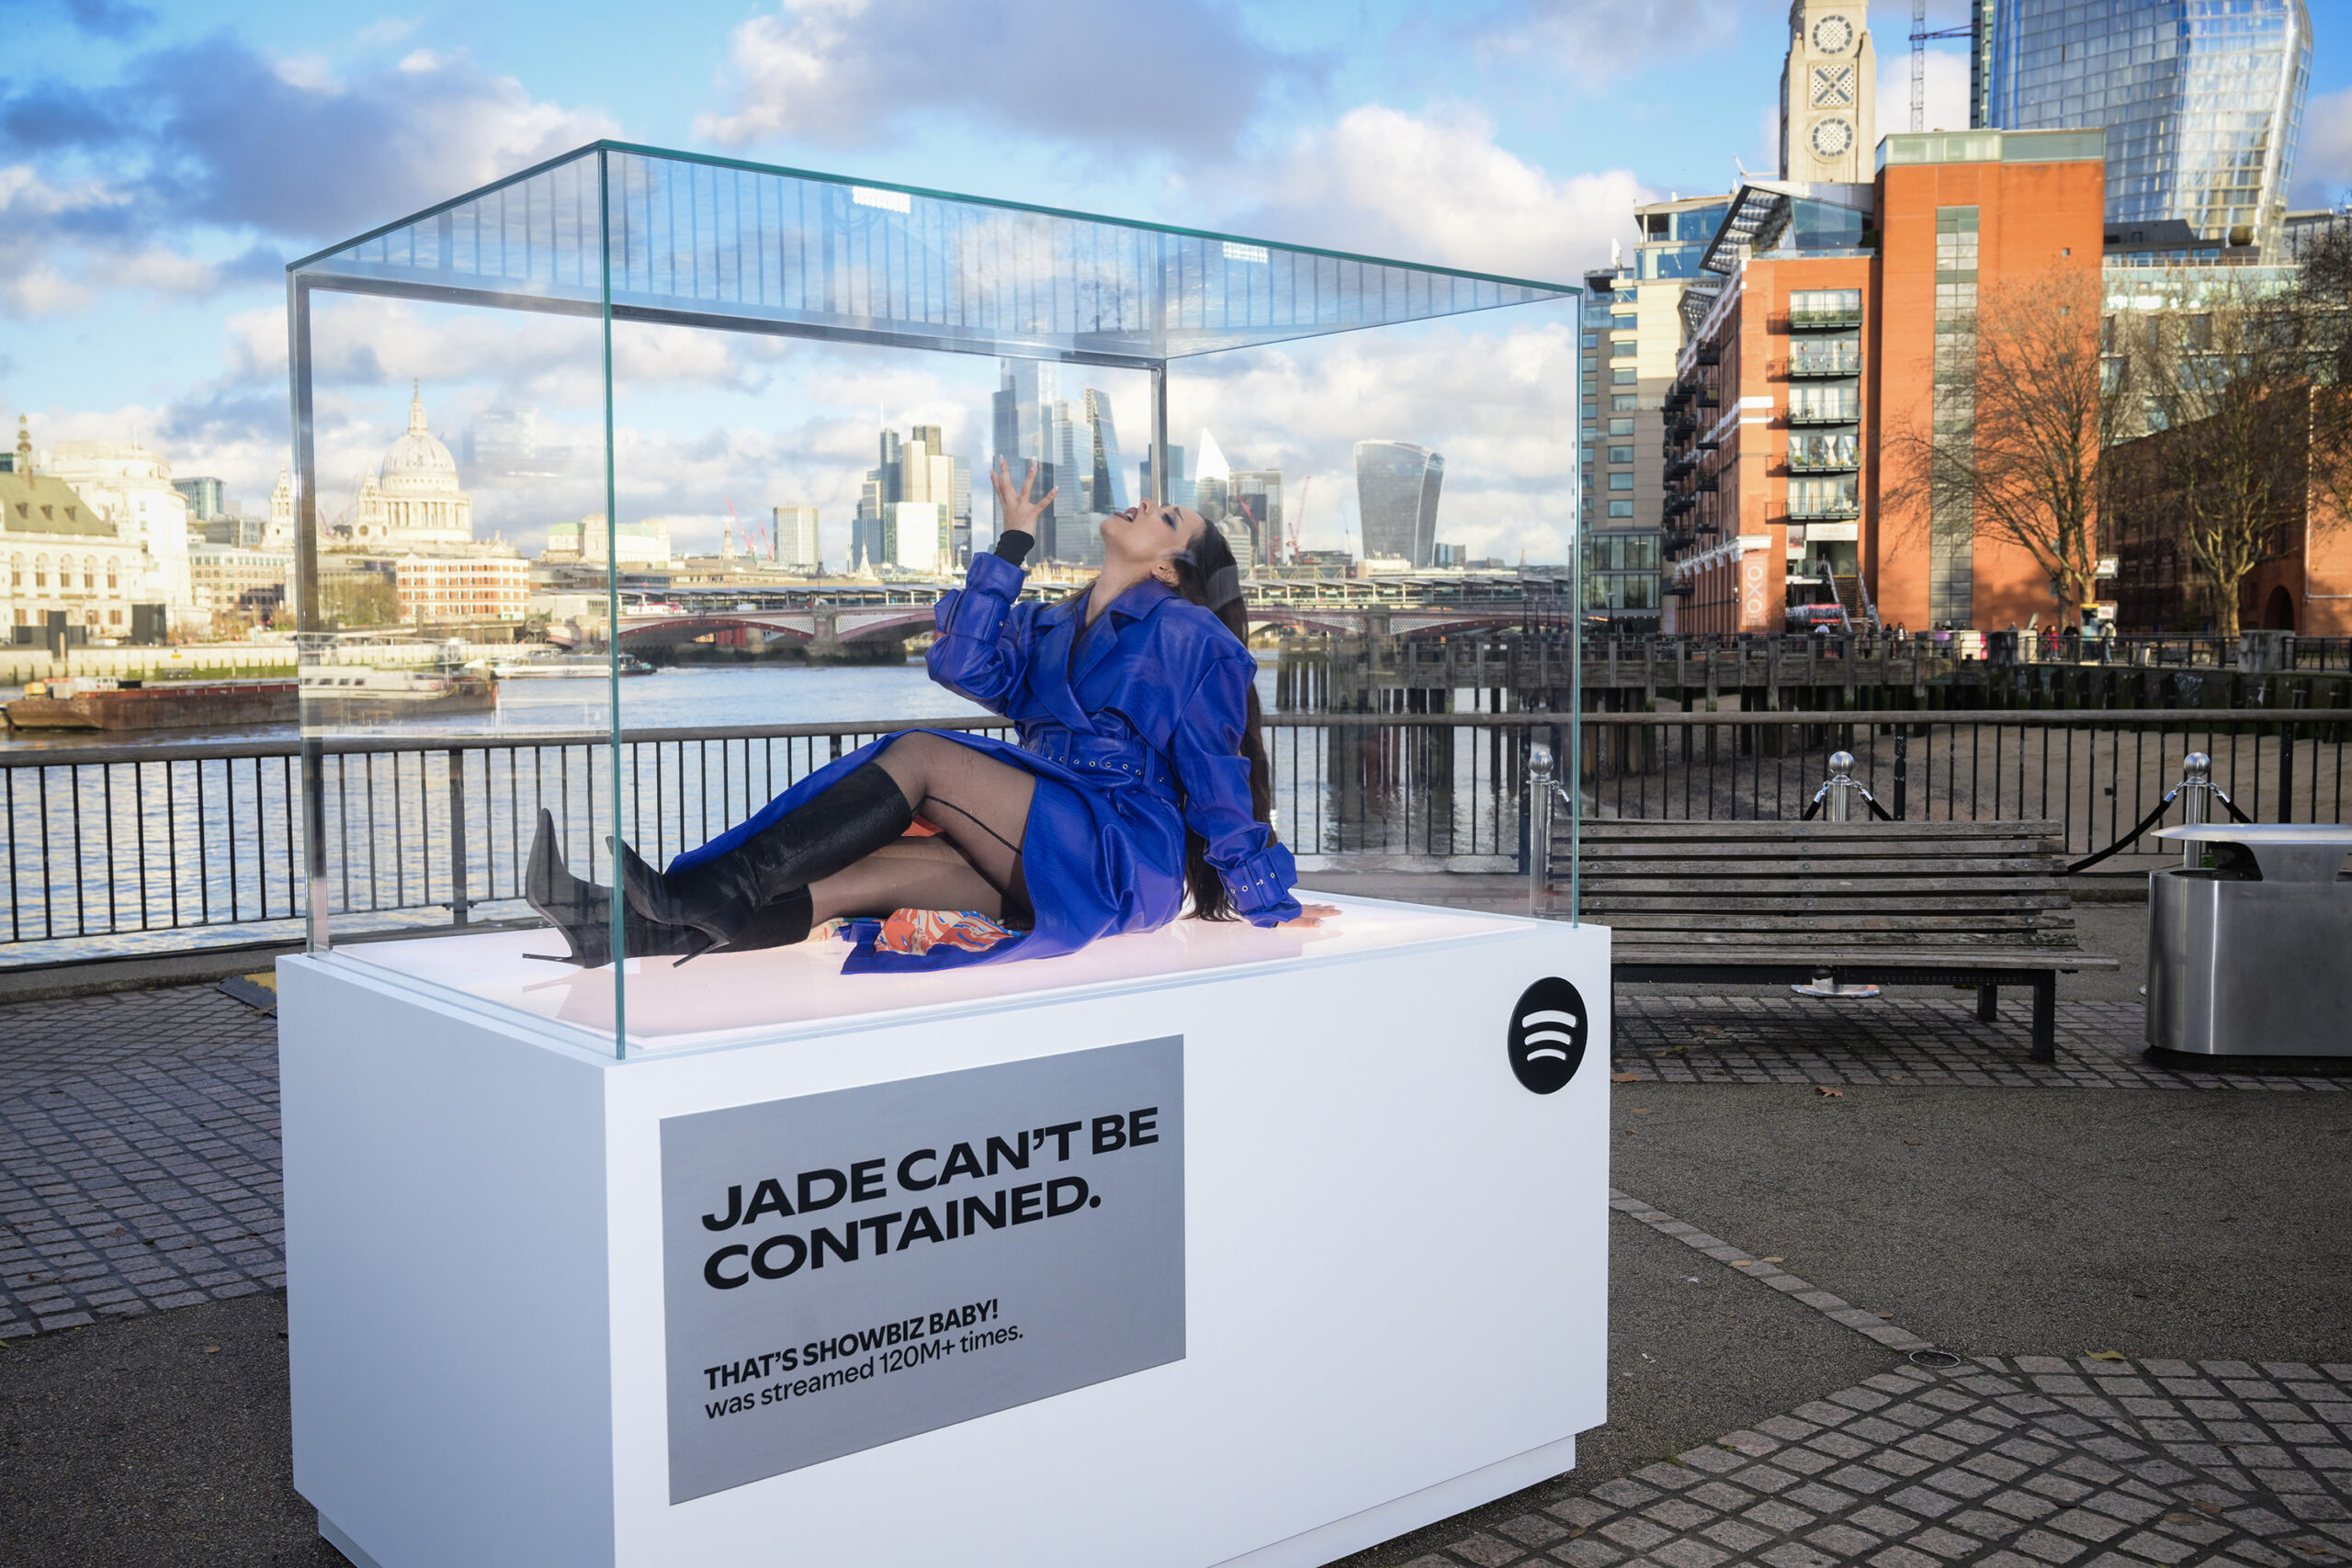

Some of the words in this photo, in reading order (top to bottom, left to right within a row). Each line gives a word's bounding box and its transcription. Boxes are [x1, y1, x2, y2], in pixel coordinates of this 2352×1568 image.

[1747, 565, 1763, 614] OXO
[701, 1157, 888, 1232] JADE
[897, 1121, 1082, 1191] CAN’T
[1091, 1106, 1159, 1155] BE
[703, 1176, 1102, 1290] CONTAINED.
[704, 1348, 798, 1391] THAT’S
[802, 1315, 925, 1367] SHOWBIZ
[929, 1298, 999, 1336] BABY!
[705, 1392, 755, 1419] was
[761, 1357, 875, 1405] streamed
[879, 1337, 956, 1374] 120M+
[958, 1320, 1024, 1354] times.
